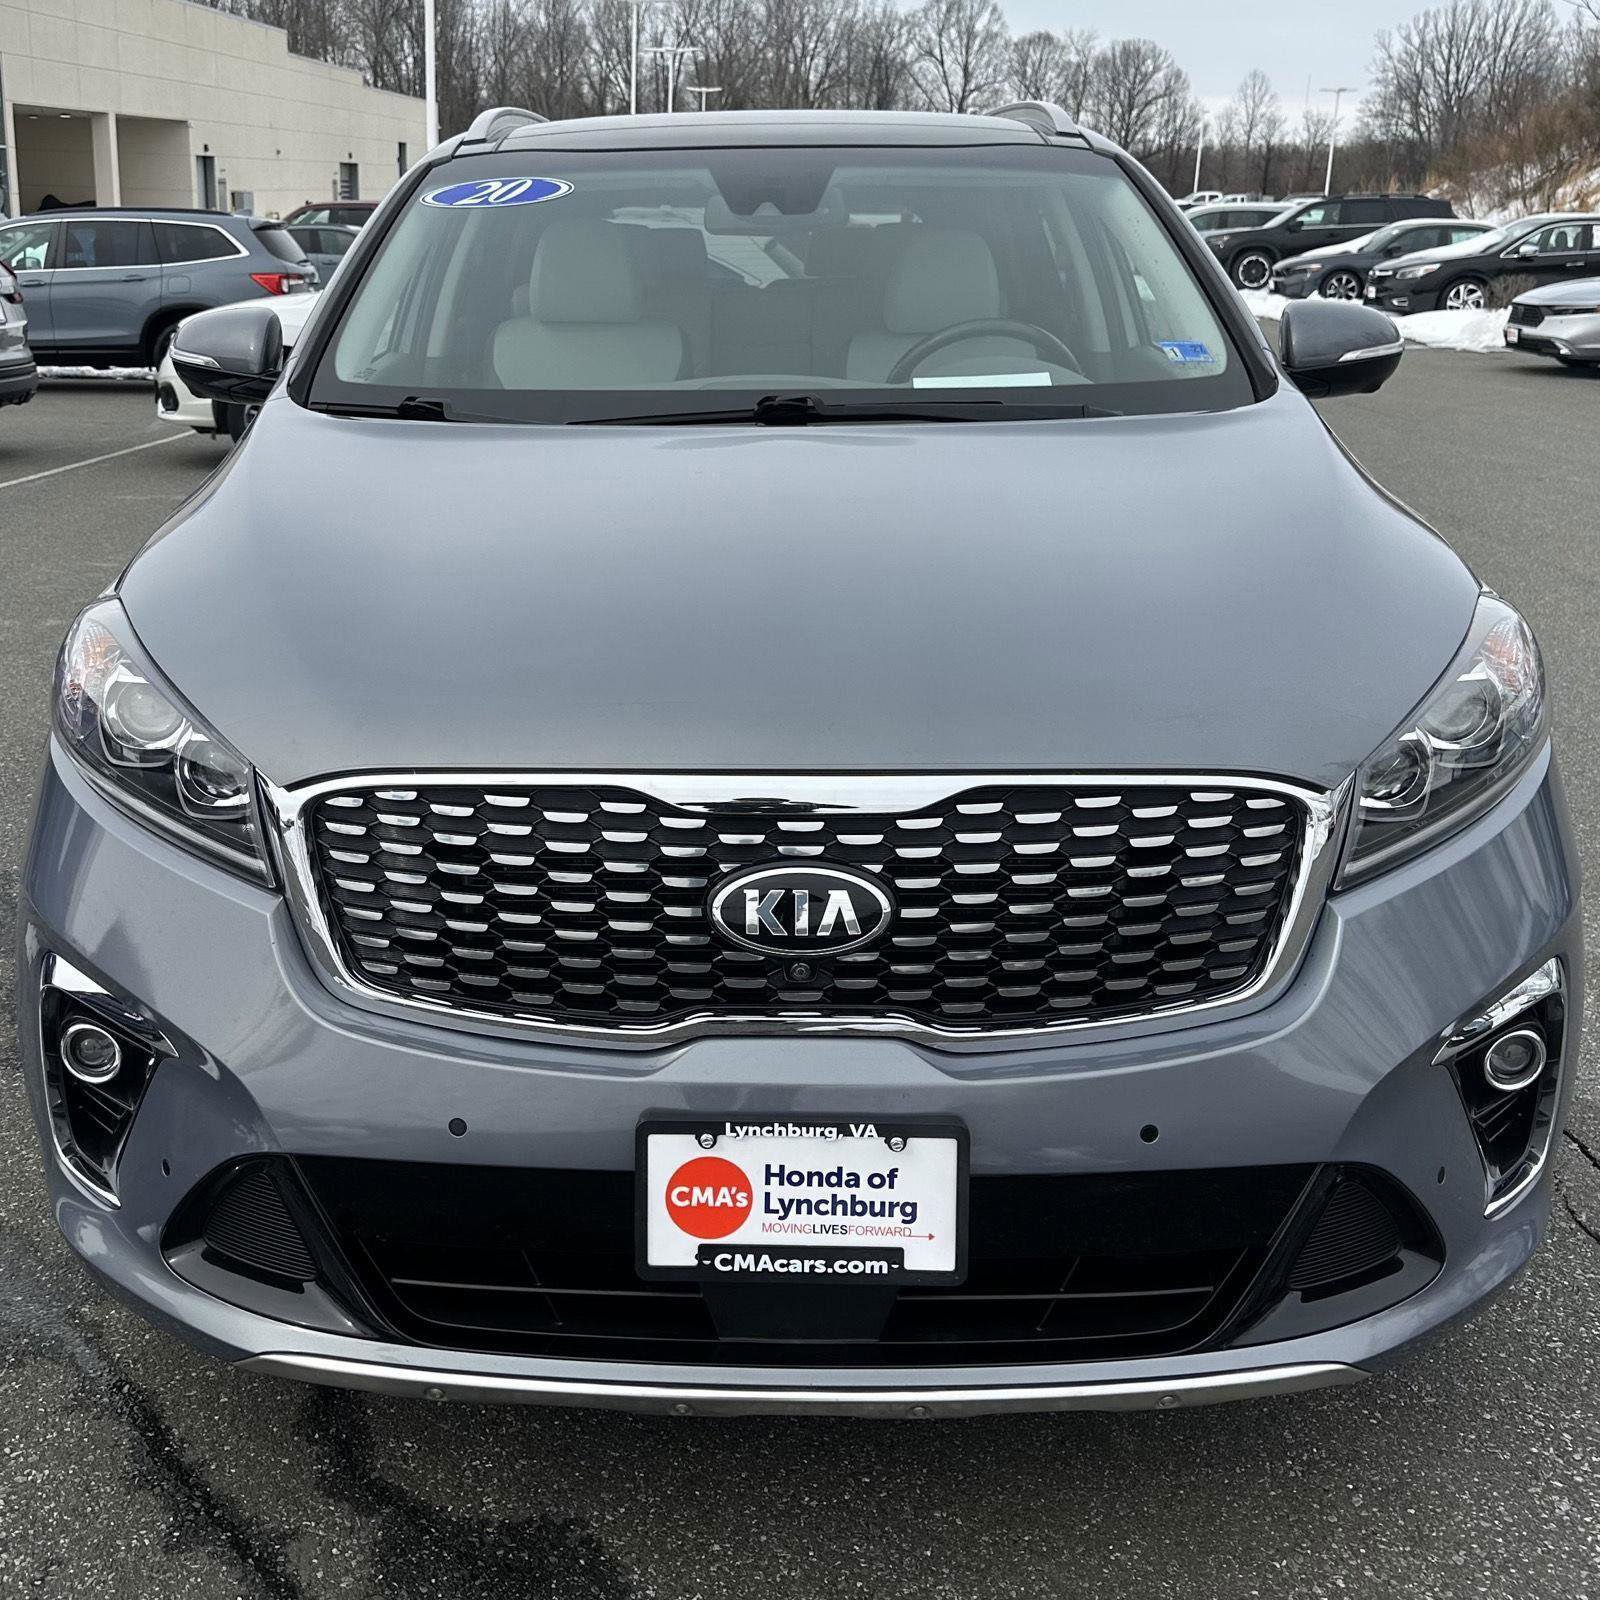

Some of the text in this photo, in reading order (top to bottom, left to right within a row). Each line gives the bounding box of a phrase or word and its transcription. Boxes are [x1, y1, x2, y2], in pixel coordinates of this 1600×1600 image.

[452, 179, 532, 206] 20
[743, 889, 862, 936] KIA
[725, 1122, 878, 1140] Lynchburg, VA
[764, 1164, 899, 1190] Honda of
[671, 1186, 749, 1208] CMA's
[764, 1192, 918, 1225] Lynchburg
[714, 1253, 888, 1275] CMAcars.com
